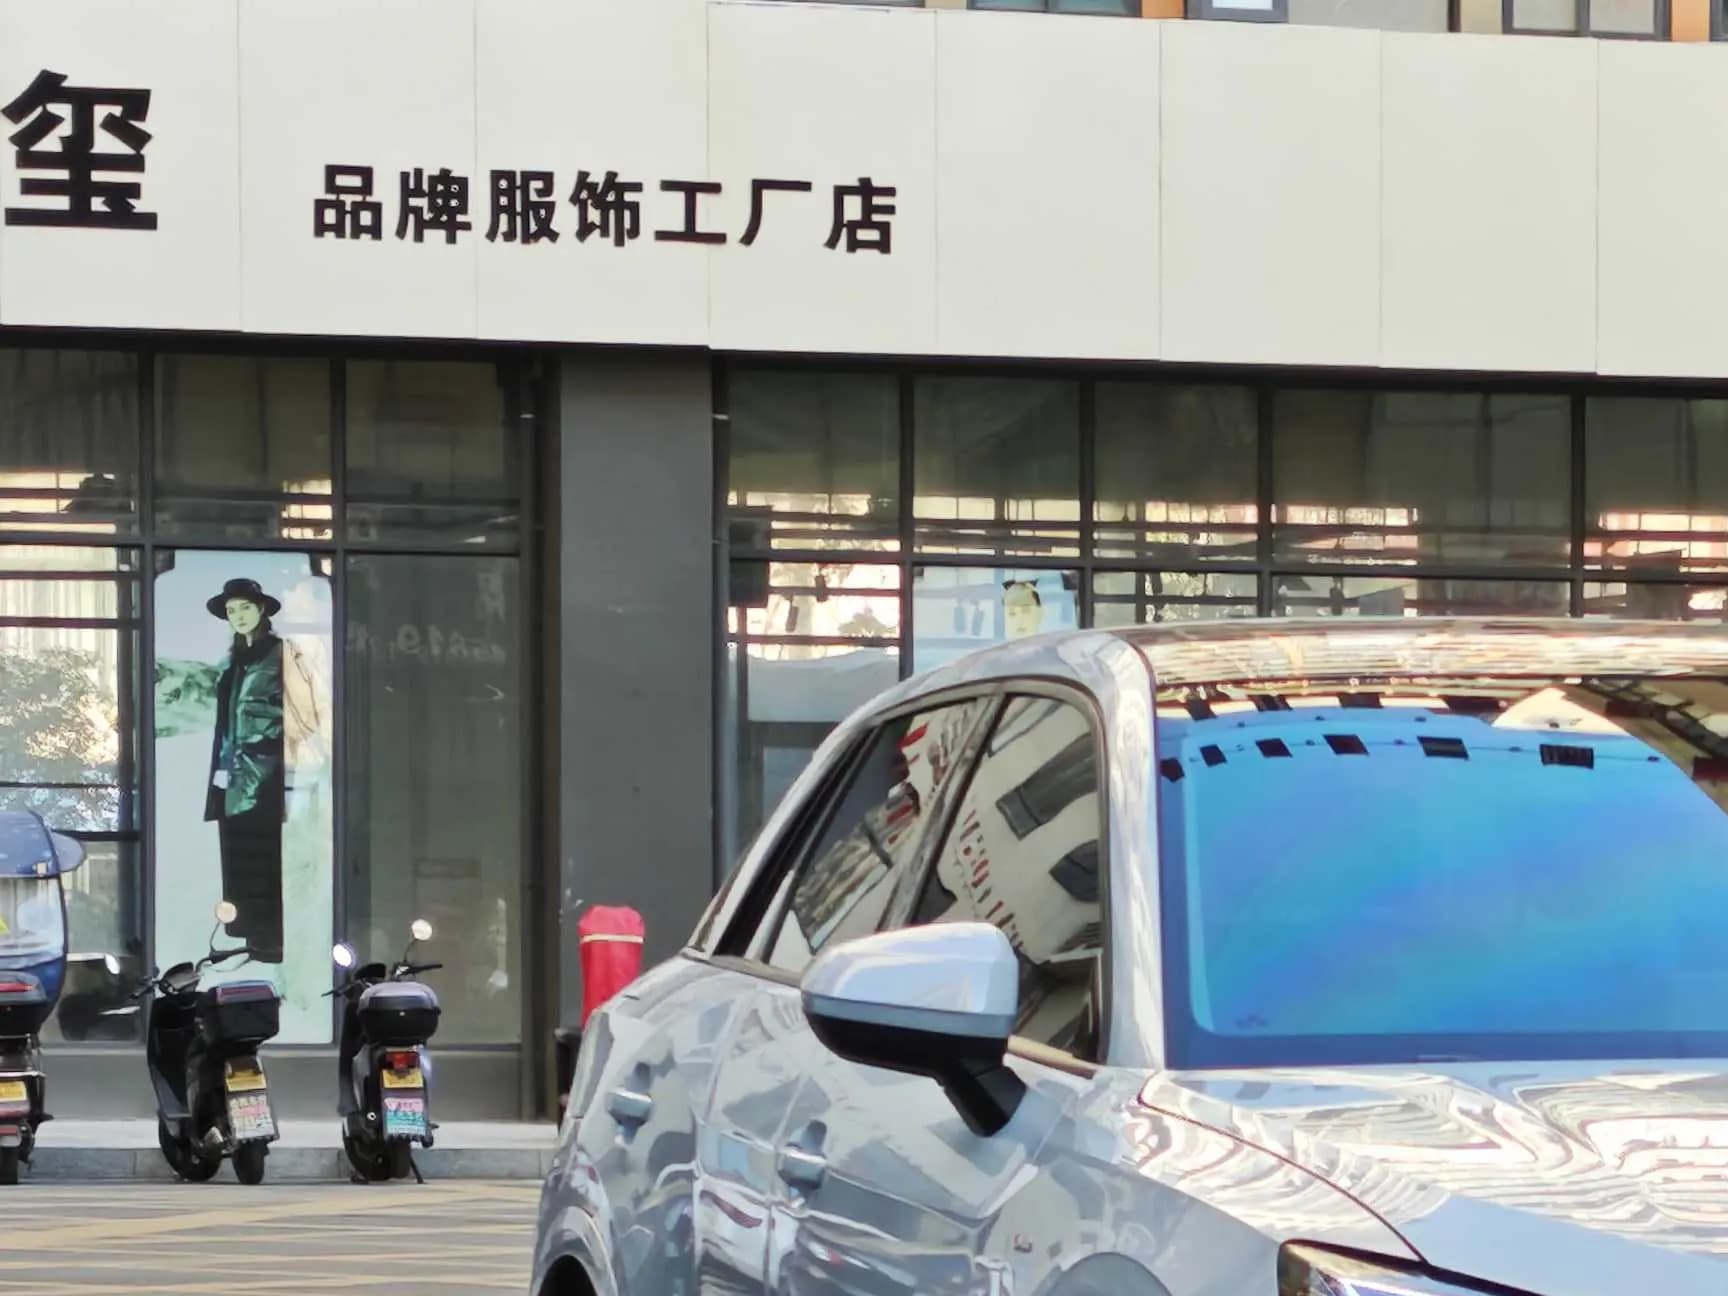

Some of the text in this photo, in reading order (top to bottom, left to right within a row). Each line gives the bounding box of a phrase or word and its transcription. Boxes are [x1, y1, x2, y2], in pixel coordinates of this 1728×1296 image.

[0, 69, 158, 230] 玺
[313, 163, 898, 255] 品牌服饰工厂店
